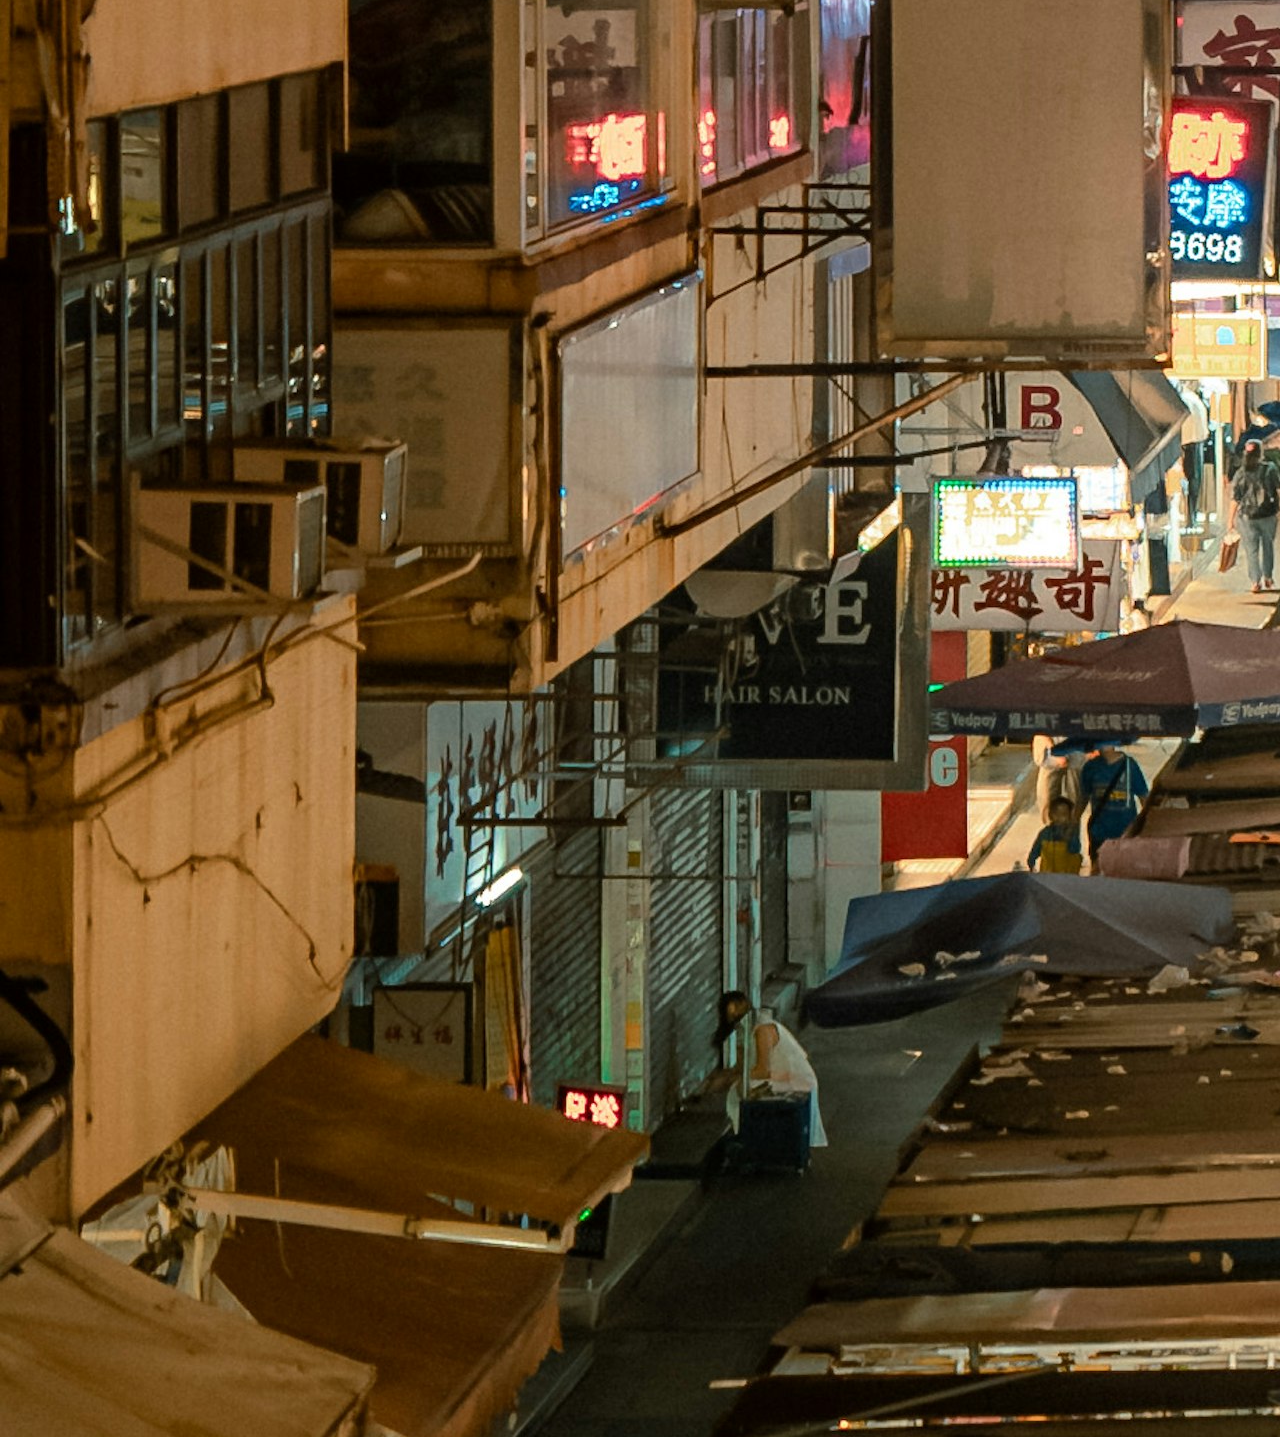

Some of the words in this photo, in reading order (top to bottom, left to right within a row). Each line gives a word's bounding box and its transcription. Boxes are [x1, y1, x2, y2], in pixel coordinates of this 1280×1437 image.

[704, 685, 763, 705] HAIR
[768, 686, 851, 706] SALON
[952, 713, 997, 732] Yedpay
